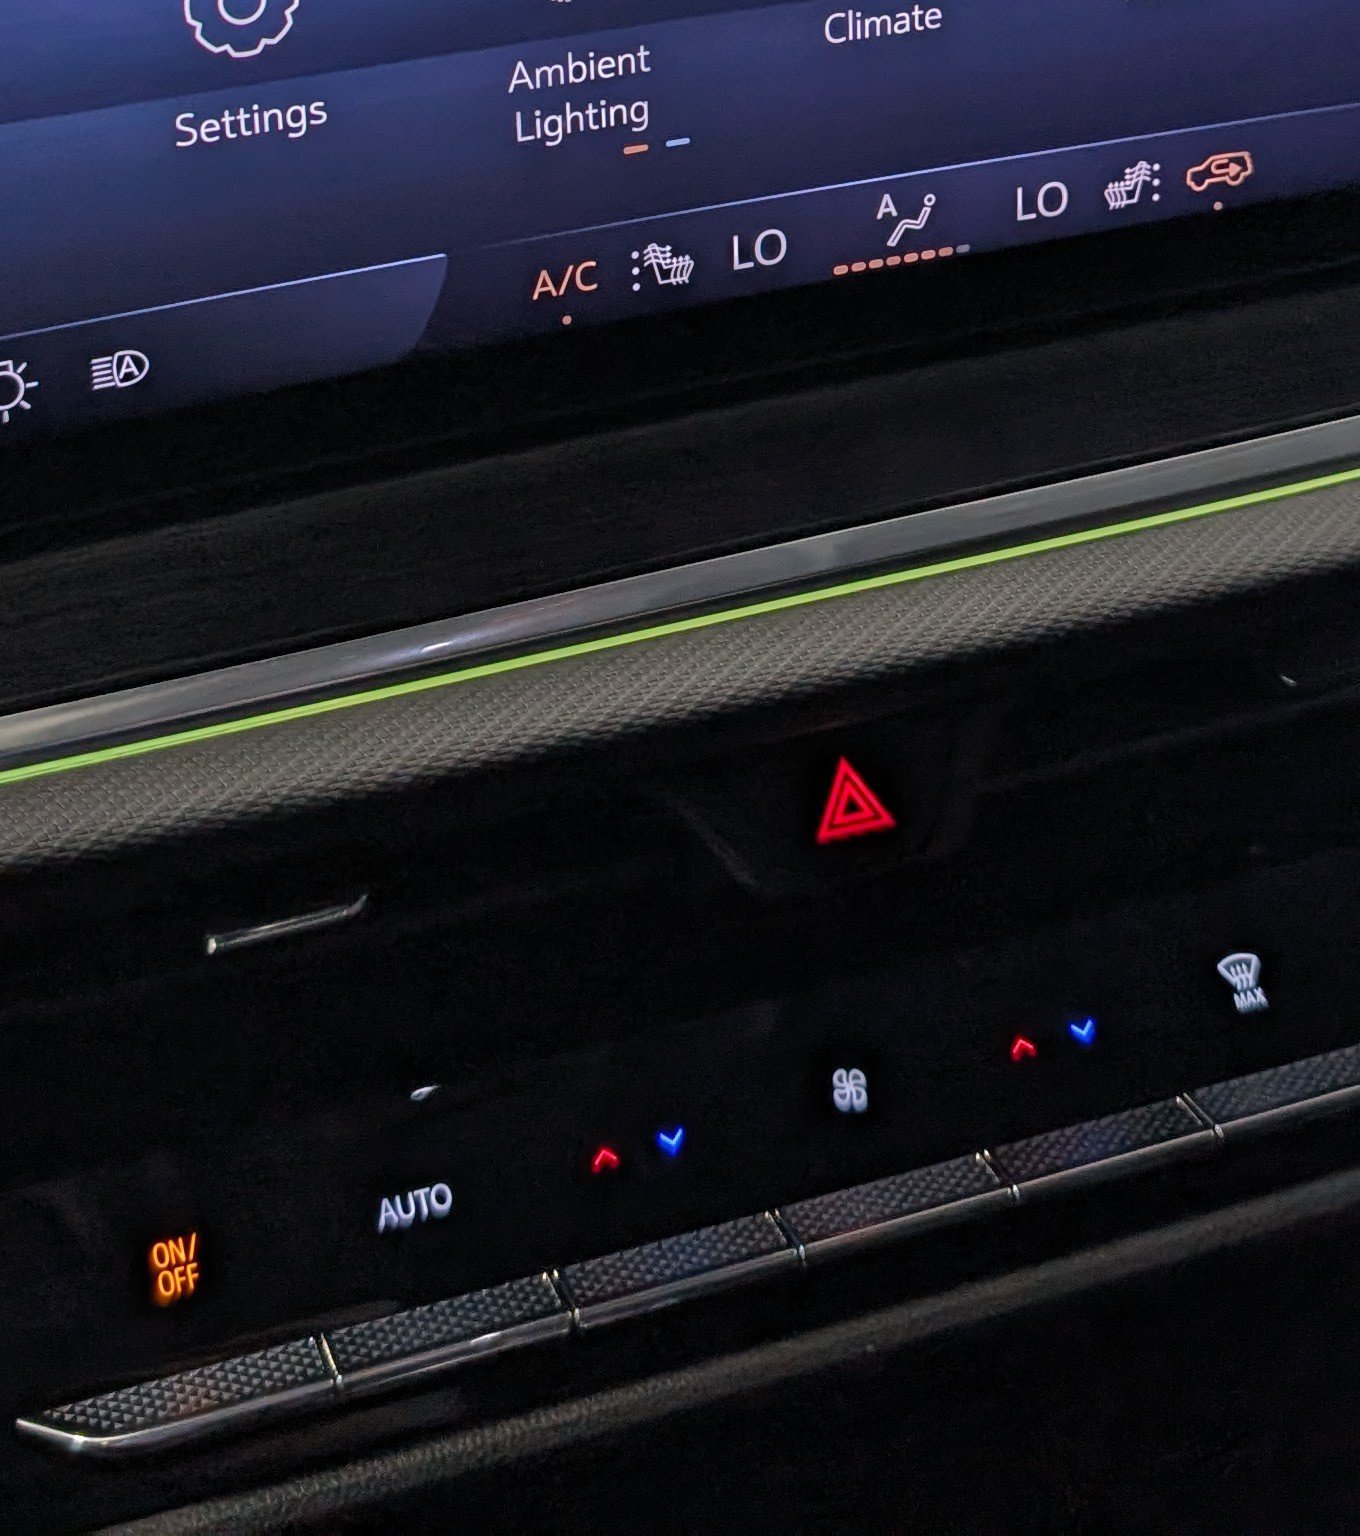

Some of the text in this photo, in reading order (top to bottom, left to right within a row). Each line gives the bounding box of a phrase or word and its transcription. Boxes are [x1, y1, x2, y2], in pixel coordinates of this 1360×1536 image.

[824, 2, 942, 44] Climate
[507, 44, 651, 93] Ambient
[174, 96, 328, 147] Settings
[515, 97, 650, 146] Lighting
[1016, 182, 1069, 221] LO
[732, 229, 787, 270] LO
[533, 261, 598, 300] A/C
[1233, 987, 1268, 1010] MAX
[378, 1183, 453, 1230] AUTO
[151, 1231, 197, 1268] ON/
[157, 1262, 200, 1297] OFF
